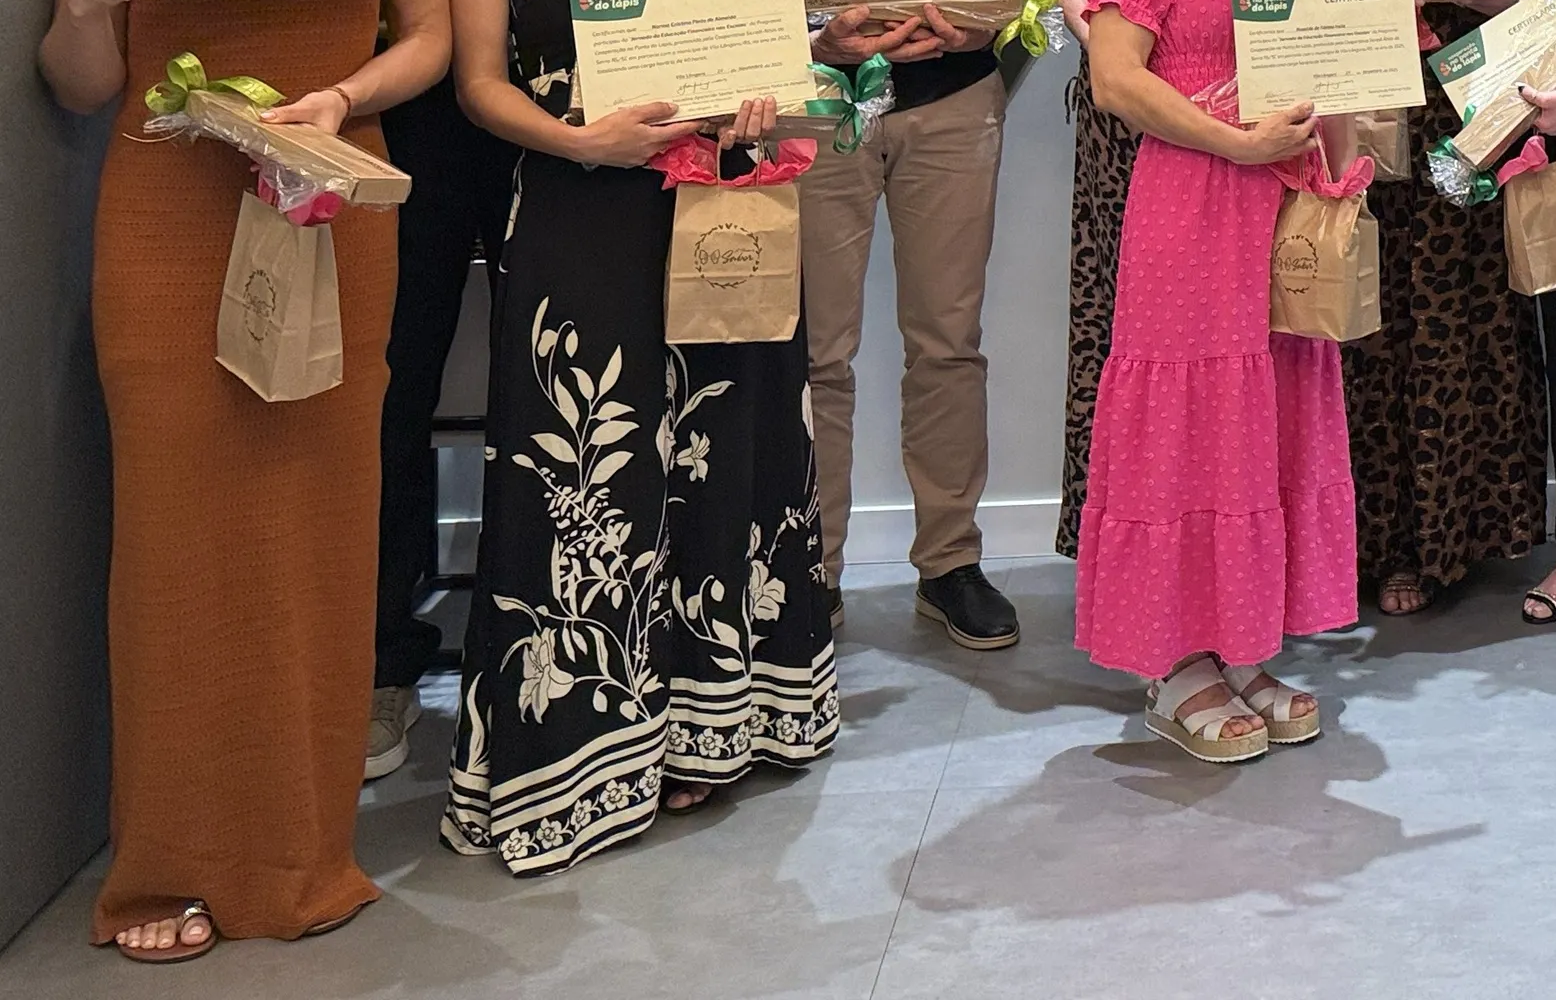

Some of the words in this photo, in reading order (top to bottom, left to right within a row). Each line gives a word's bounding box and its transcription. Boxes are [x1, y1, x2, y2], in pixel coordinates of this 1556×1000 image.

[594, 1, 609, 10] do
[1252, 4, 1264, 12] do
[1265, 2, 1287, 13] lápis
